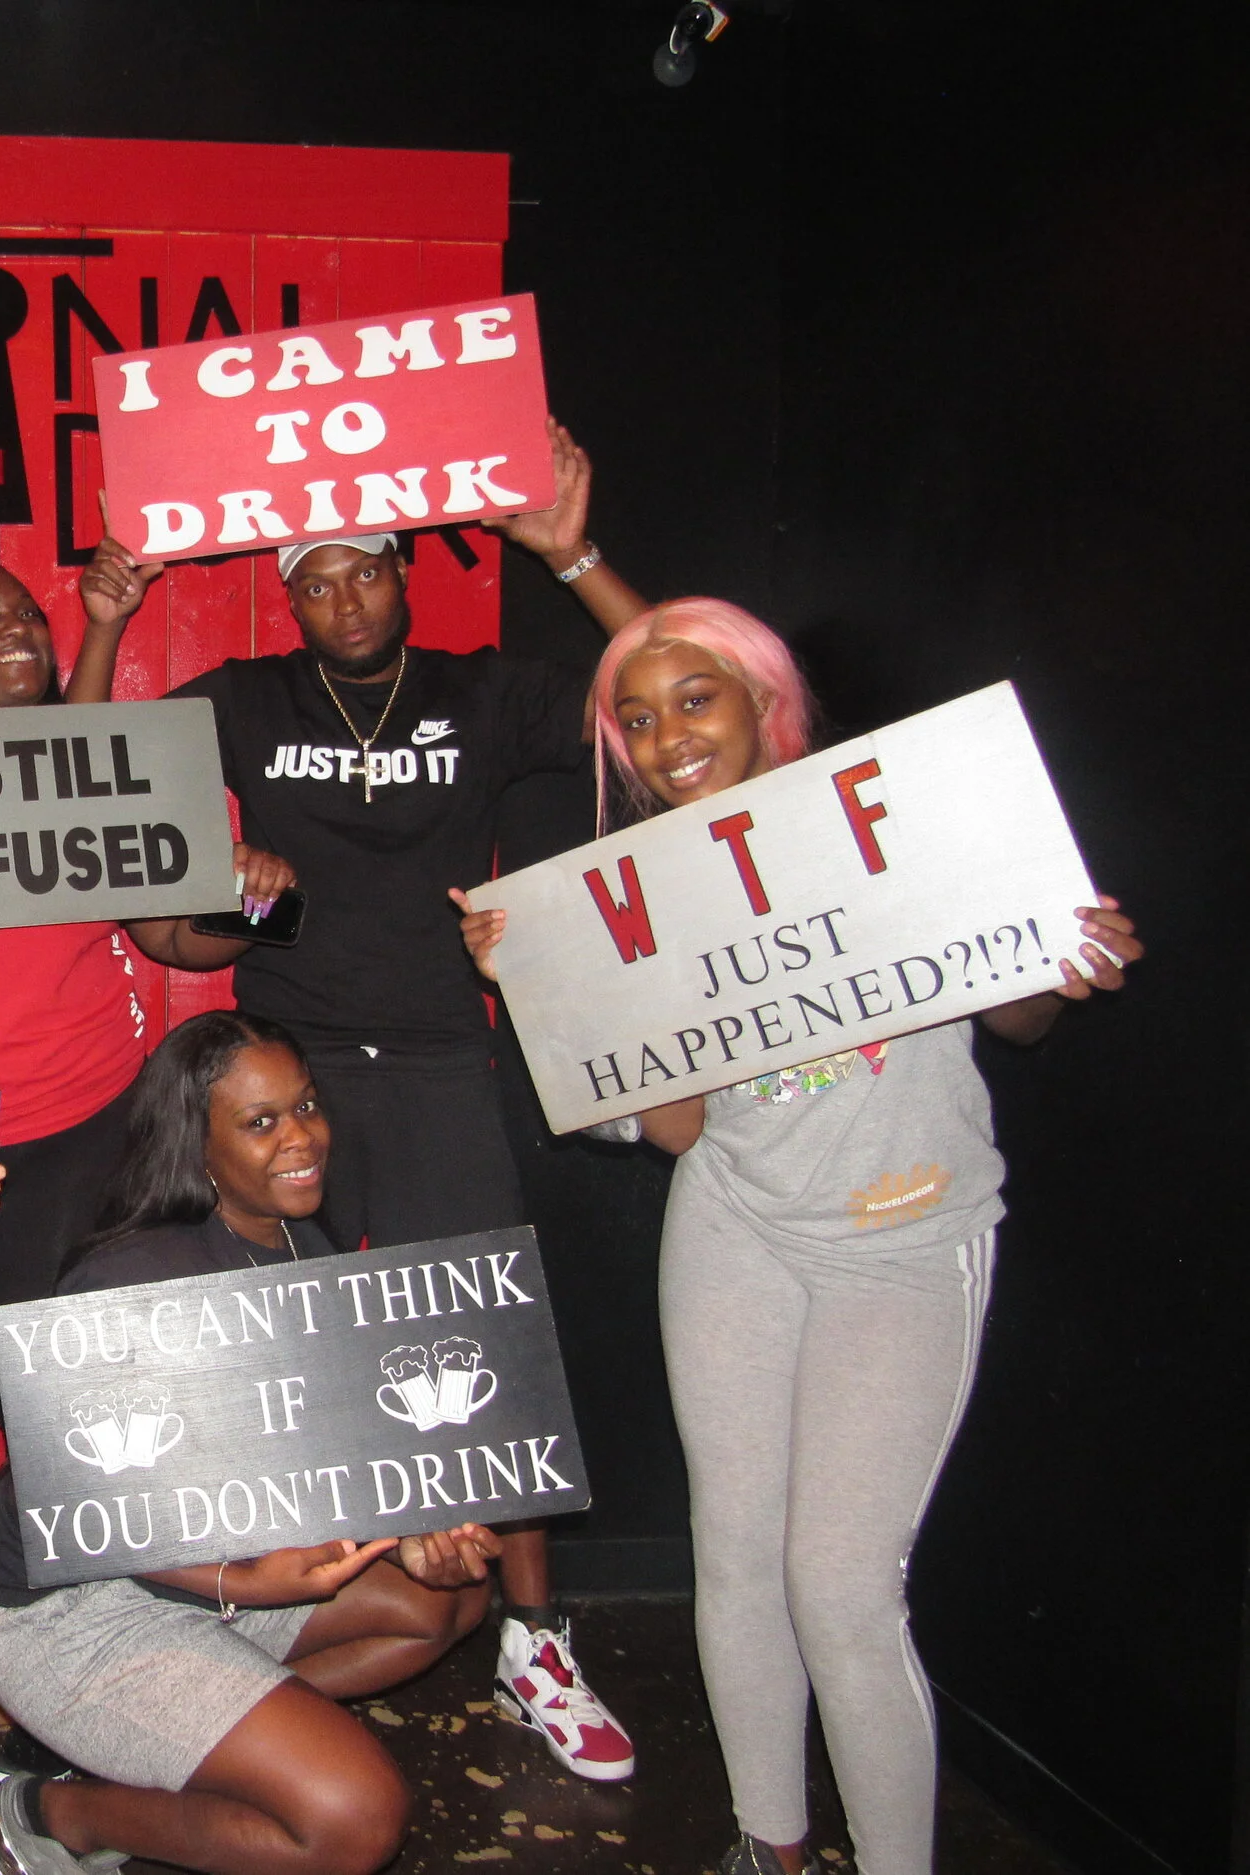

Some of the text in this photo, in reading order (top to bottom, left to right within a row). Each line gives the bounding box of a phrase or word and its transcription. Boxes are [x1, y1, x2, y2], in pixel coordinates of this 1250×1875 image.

[118, 307, 517, 413] I CAME
[255, 400, 387, 465] TO
[140, 455, 528, 556] DRINK
[264, 745, 459, 786] JUST DO IT
[417, 720, 450, 736] NIKE
[696, 908, 849, 999] JUST
[580, 918, 1052, 1103] HAPPENED?!?!
[865, 1181, 936, 1212] NICKELODEON
[4, 1251, 534, 1375] YOU CAN'T THINK
[254, 1376, 306, 1435] IF
[26, 1435, 574, 1561] YOU DON'T DRINK
